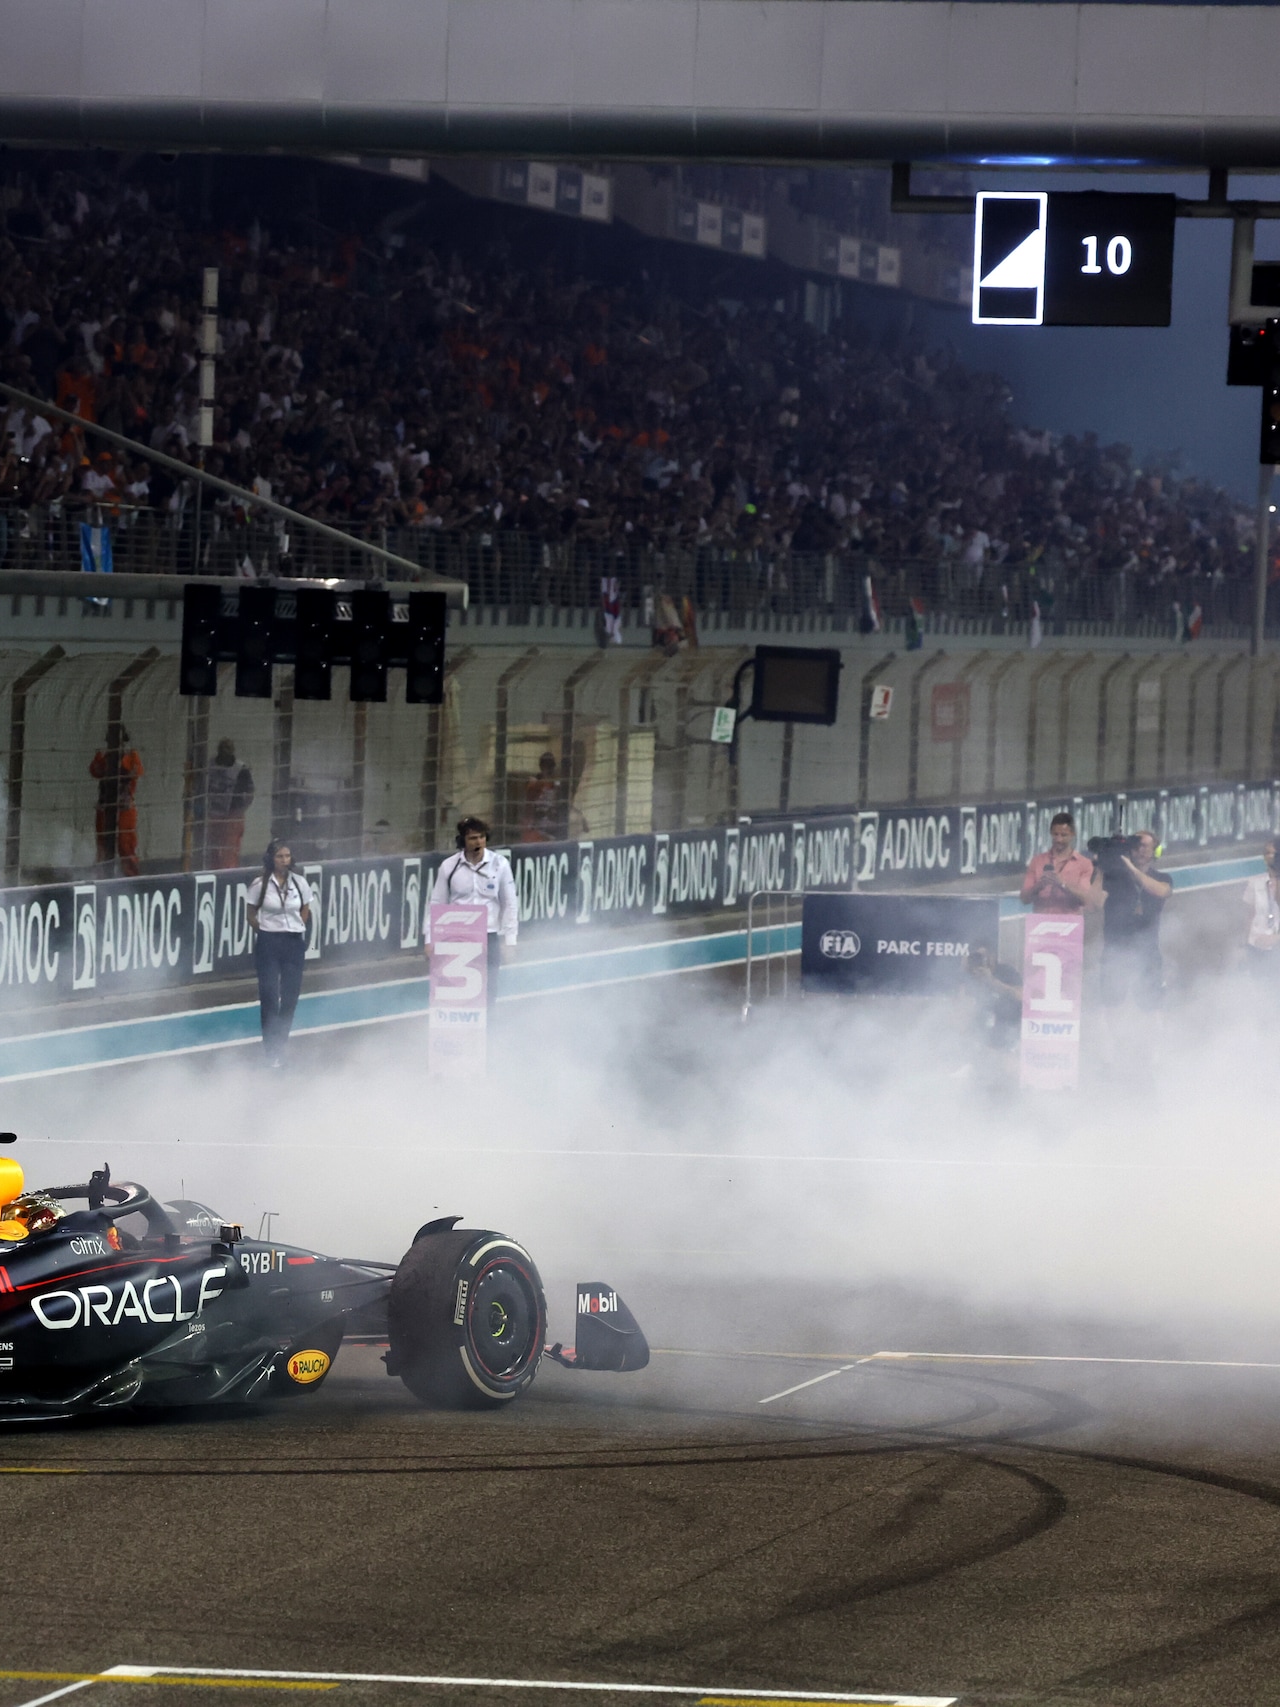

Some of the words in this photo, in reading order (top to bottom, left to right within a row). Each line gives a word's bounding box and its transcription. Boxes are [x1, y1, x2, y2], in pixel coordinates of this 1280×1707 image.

[1081, 235, 1132, 275] 10
[670, 840, 718, 903] ADNOC
[738, 832, 786, 894] ADNOC
[806, 827, 850, 886] ADNOC
[879, 815, 950, 871] ADNOC
[325, 868, 391, 946] ADNOC
[593, 844, 647, 912] ADNOC
[101, 888, 182, 973] ADNOC
[877, 940, 921, 955] PARC
[434, 942, 483, 1000] 3
[1029, 953, 1073, 1012] 1
[70, 1236, 106, 1255] citrix
[241, 1249, 286, 1274] BYBIT
[31, 1267, 227, 1330] ORACLE
[578, 1292, 618, 1313] Mobil
[299, 1359, 326, 1373] RAUCH
